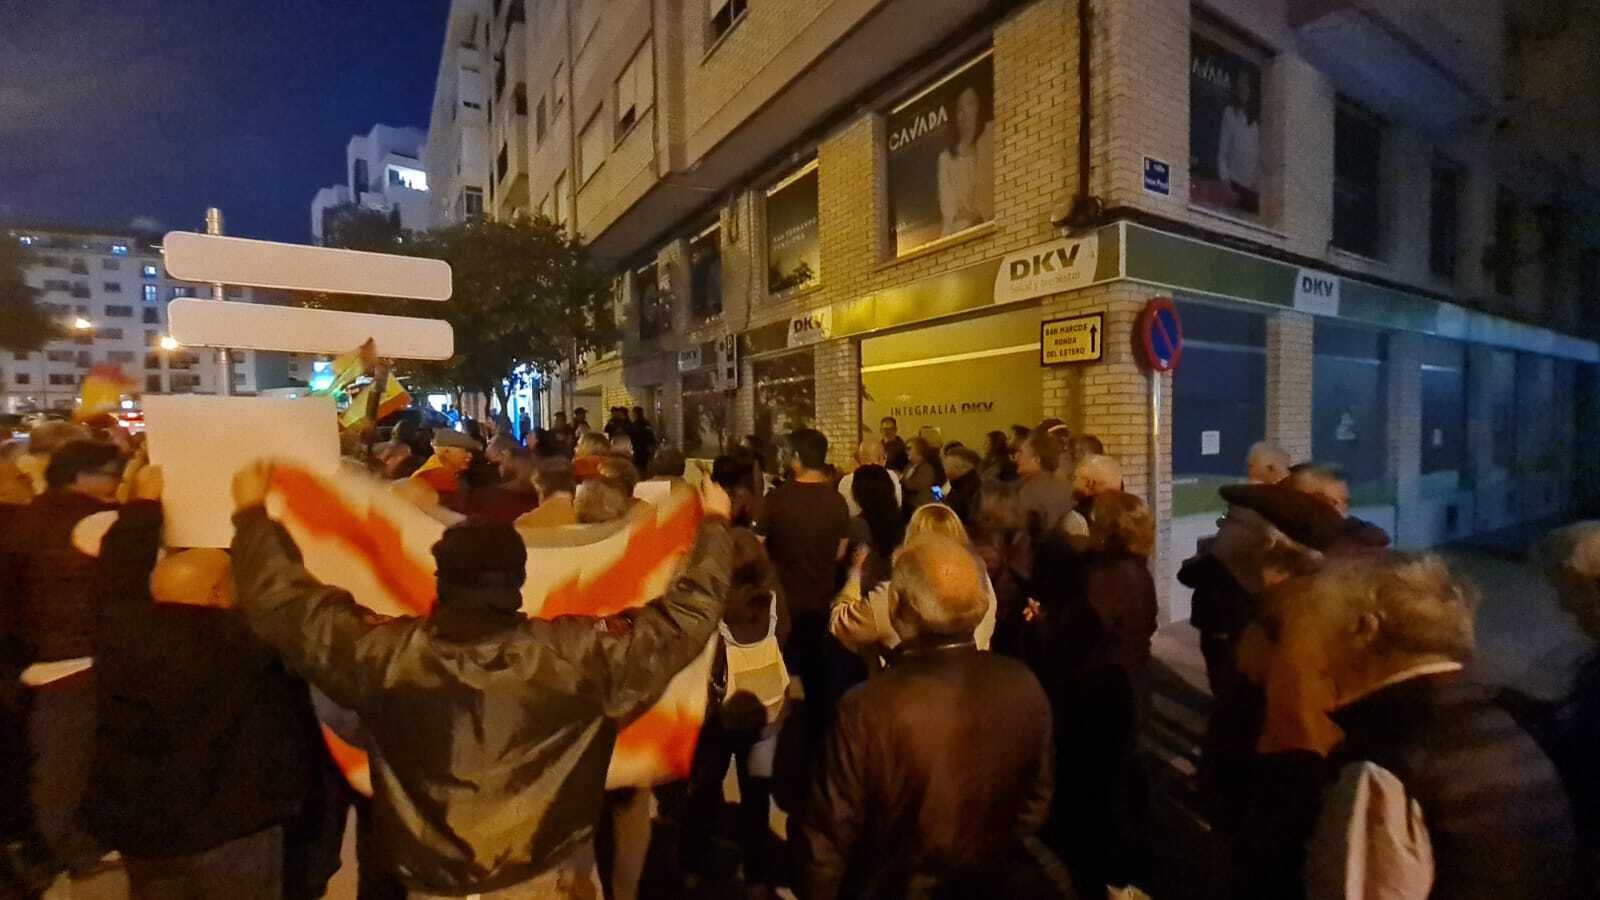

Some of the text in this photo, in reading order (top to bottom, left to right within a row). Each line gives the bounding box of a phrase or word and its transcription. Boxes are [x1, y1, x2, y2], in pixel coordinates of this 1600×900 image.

[889, 105, 948, 151] CAVADA
[1010, 243, 1080, 281] DKV
[1302, 276, 1333, 297] DKV
[890, 401, 993, 417] INTEGRALIA DKV
